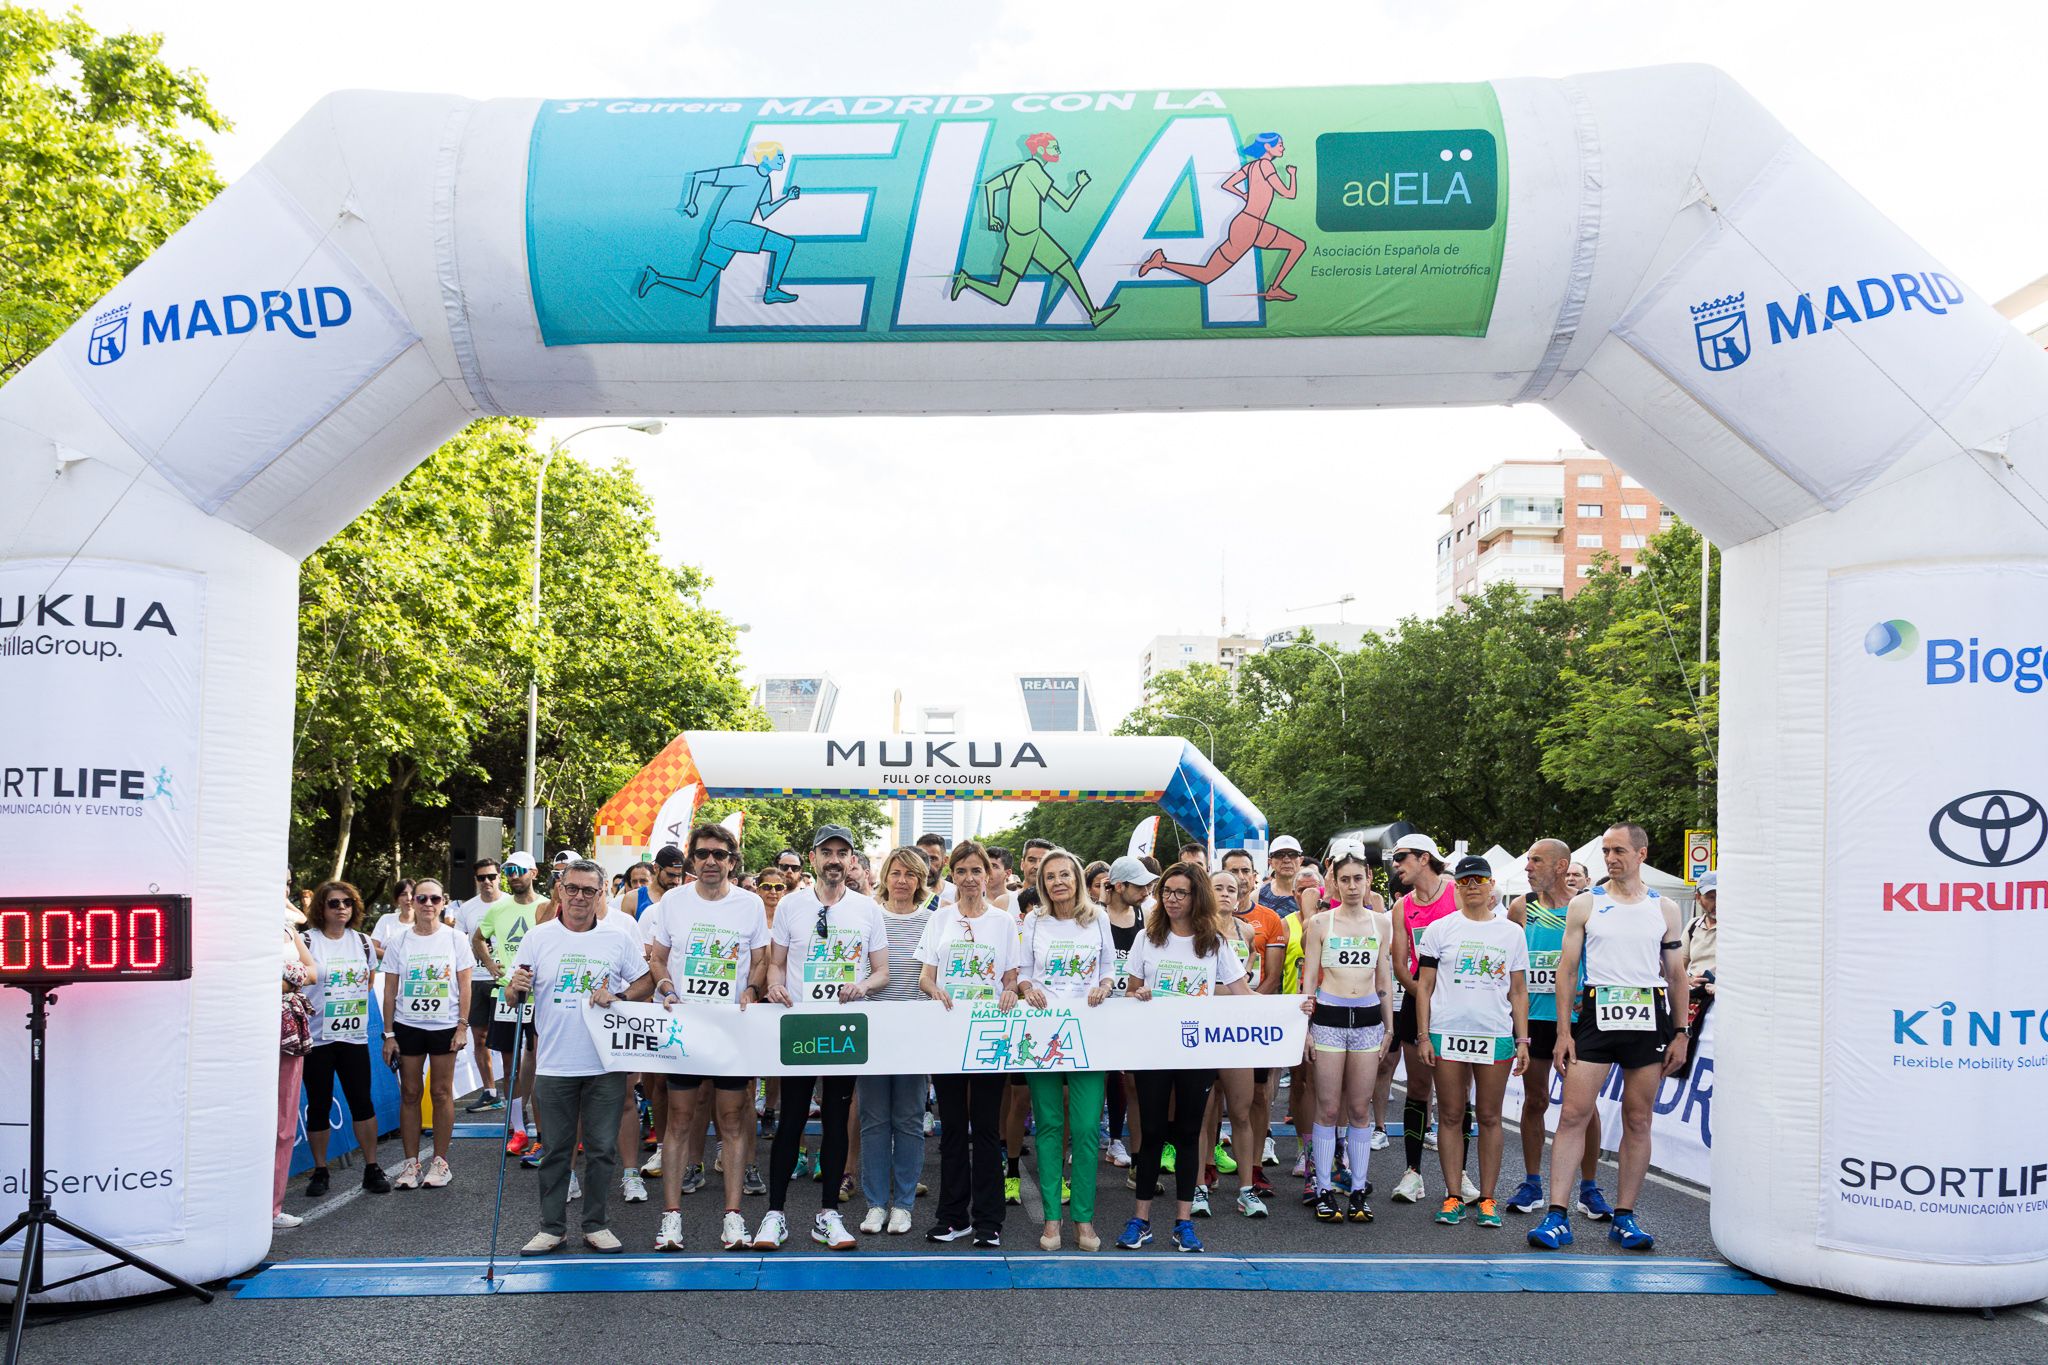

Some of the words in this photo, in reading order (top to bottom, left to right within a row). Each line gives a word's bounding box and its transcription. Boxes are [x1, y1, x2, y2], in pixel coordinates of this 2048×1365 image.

[605, 101, 743, 114] Carrera
[757, 95, 994, 117] MADRID
[1011, 93, 1136, 112] CON
[1153, 90, 1227, 110] LA
[1342, 171, 1472, 207] adELA
[708, 113, 1267, 333] ELA
[1312, 245, 1381, 257] Asociación
[1384, 244, 1440, 258] Española
[1443, 244, 1460, 256] de
[1310, 265, 1372, 277] Esclerosis
[1375, 264, 1417, 276] Lateral
[1420, 263, 1492, 276] Amiotrófica
[142, 286, 352, 345] MADRID
[1765, 271, 1964, 345] MADRID
[0, 594, 177, 636] UKUA
[1926, 637, 2048, 693] Biog
[826, 740, 1048, 768] MUKUA
[883, 774, 910, 784] FULL
[914, 774, 930, 784] OF
[934, 775, 991, 785] COLOURS
[75, 804, 82, 814] Y
[85, 804, 143, 817] EVENTOS
[1883, 880, 2048, 912] KURUM
[1338, 951, 1371, 965] 828
[686, 978, 730, 997] 1278
[1607, 989, 1641, 1003] ELA
[411, 998, 441, 1012] 639
[970, 1009, 1022, 1019] MADRID
[1025, 1008, 1053, 1018] CON
[1056, 1008, 1072, 1017] LA
[1601, 1005, 1651, 1021] 1094
[331, 1017, 360, 1032] 640
[603, 1013, 668, 1033] SPORT
[1892, 1001, 2048, 1047] KINT
[611, 1032, 659, 1052] LIFE
[792, 1036, 856, 1055] adELA
[962, 1018, 1089, 1071] ELA
[1205, 1026, 1284, 1047] MADRID
[1447, 1036, 1488, 1055] 1012
[1893, 1054, 1954, 1069] Flexible
[1958, 1056, 2014, 1071] Mobility
[2017, 1054, 2048, 1068] Soluti
[43, 1167, 173, 1194] Services
[1839, 1157, 2048, 1198] SPORTLIF
[1841, 1191, 1916, 1213] MOVILIDAD,
[1920, 1201, 2014, 1215] COMUNICACIÓN
[2017, 1203, 2024, 1213] Y
[2025, 1199, 2048, 1213] EVEN
